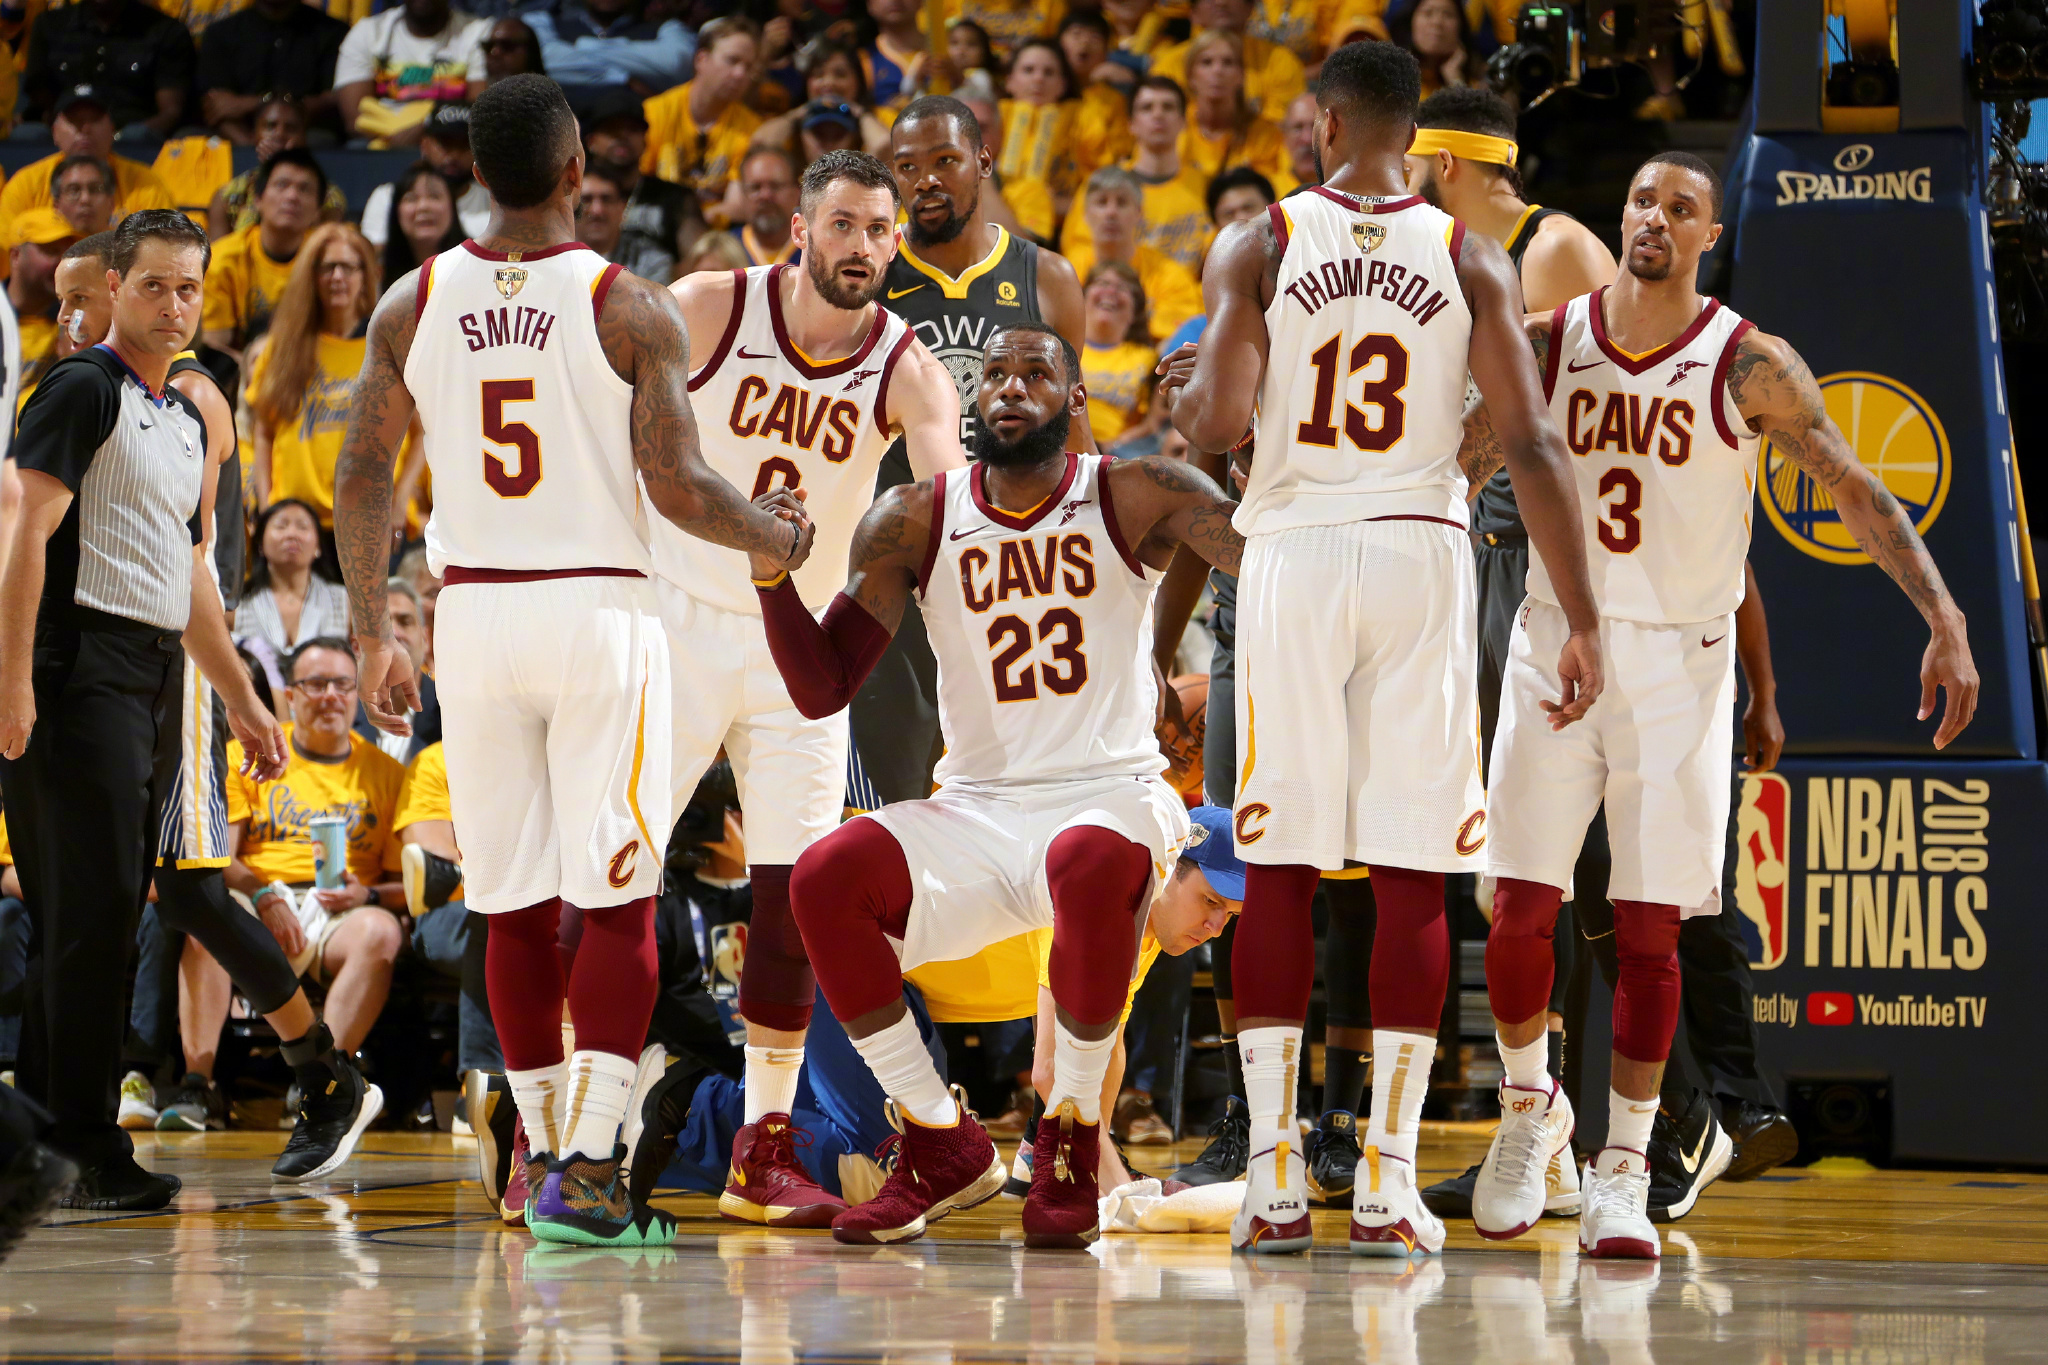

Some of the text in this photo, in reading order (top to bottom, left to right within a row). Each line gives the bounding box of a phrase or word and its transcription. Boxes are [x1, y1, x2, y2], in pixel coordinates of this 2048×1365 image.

[1342, 192, 1386, 204] NIKE PRO
[1776, 166, 1932, 207] SPALDING
[1352, 223, 1385, 238] NBA FINALS
[458, 305, 556, 352] SMITH
[995, 298, 1021, 308] Rakuten
[1284, 257, 1450, 327] THOMPSON
[728, 373, 861, 465] CAVS
[1296, 328, 1411, 454] 13
[1567, 387, 1697, 468] CAVS
[480, 377, 544, 500] 5
[1597, 466, 1644, 556] 3
[958, 532, 1098, 615] CAVS
[986, 606, 1090, 705] 23
[1806, 777, 1991, 873] NBA 2018
[1804, 873, 1989, 971] FINALS
[1779, 993, 1799, 1028] by
